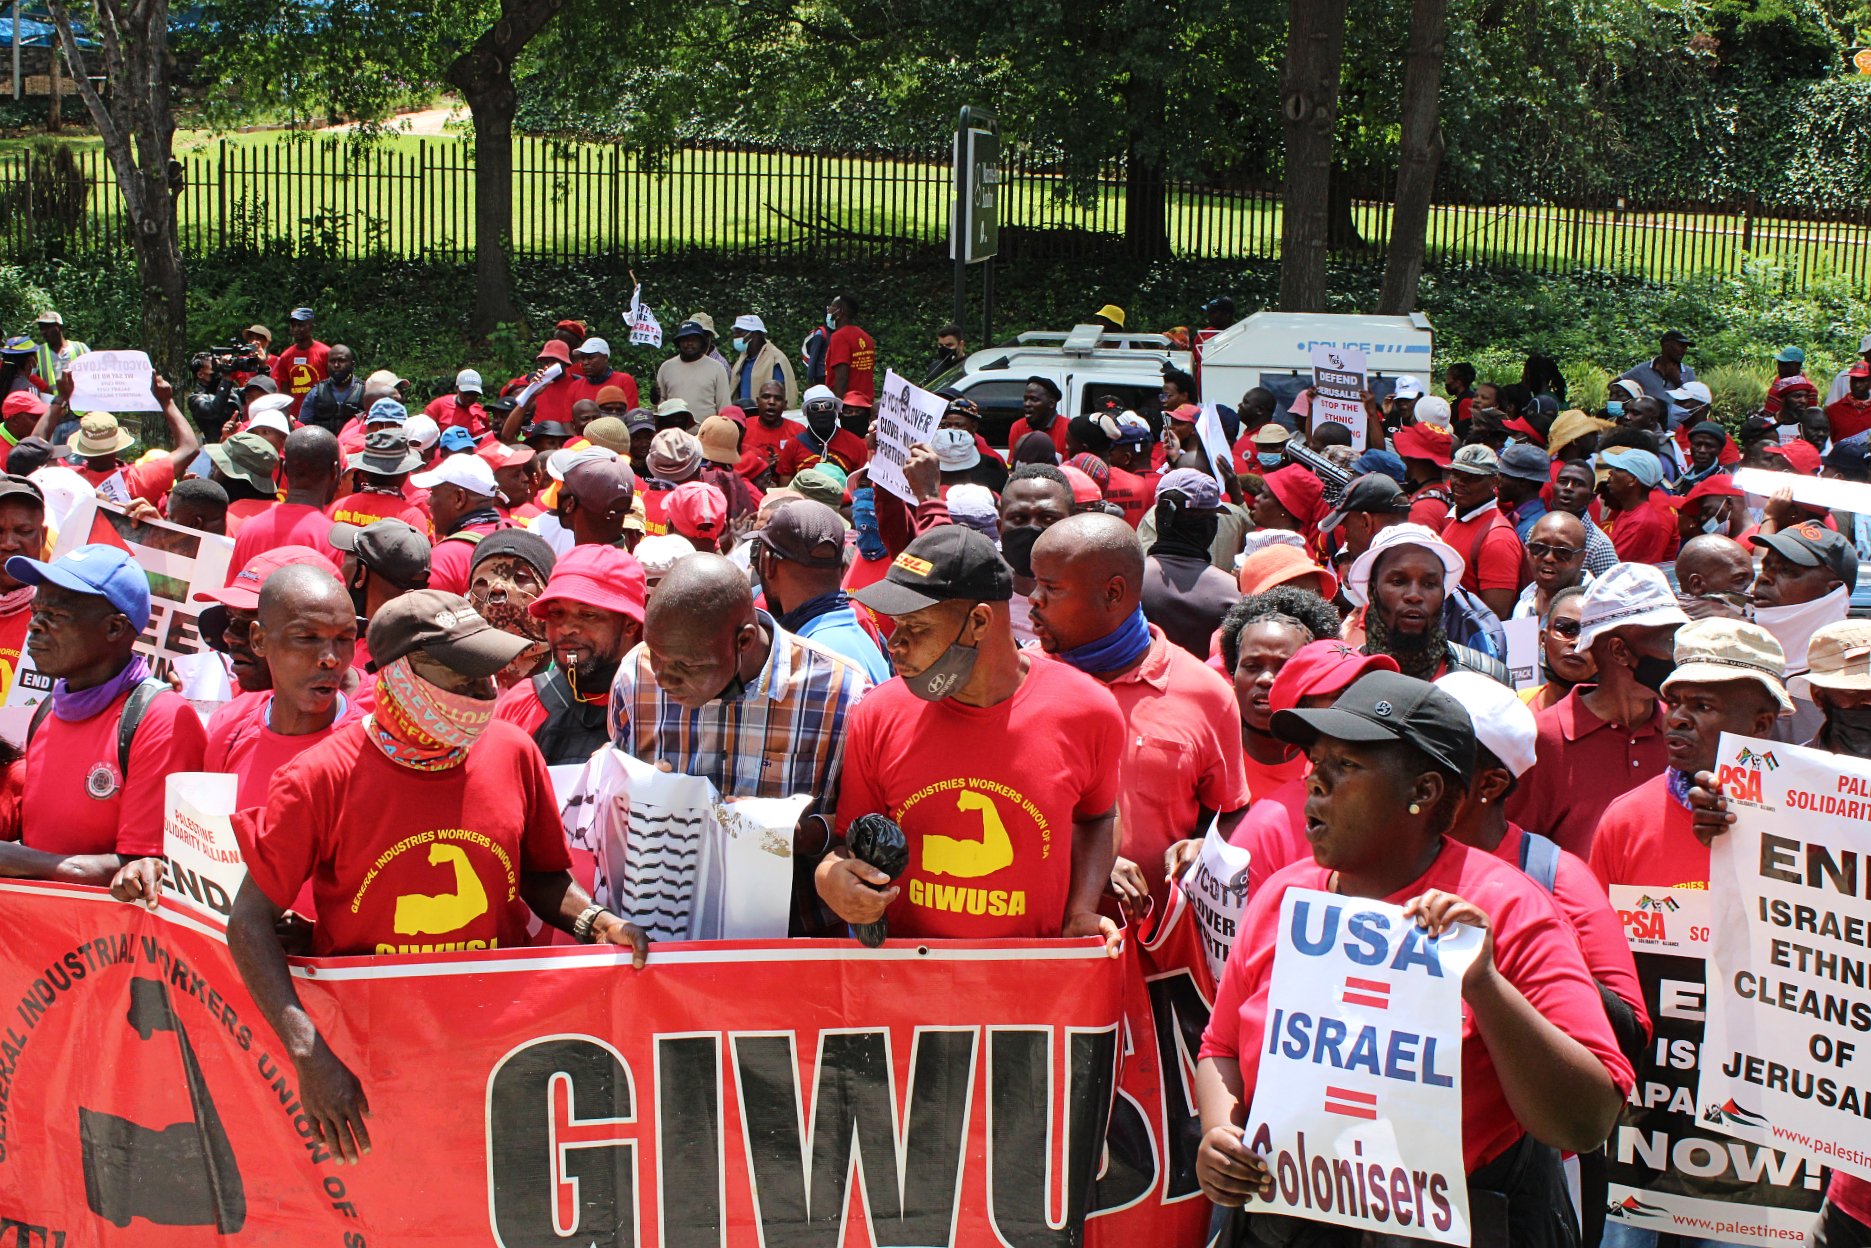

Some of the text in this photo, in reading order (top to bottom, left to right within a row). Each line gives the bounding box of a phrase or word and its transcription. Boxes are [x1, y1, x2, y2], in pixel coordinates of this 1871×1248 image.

[1308, 341, 1370, 354] PICE
[1320, 371, 1358, 385] DEFEND
[1321, 400, 1358, 412] STOP THE
[1325, 413, 1353, 424] ETHNIC
[0, 648, 20, 658] ORKE
[23, 672, 51, 689] END
[904, 777, 966, 811] INDUSTRIES
[968, 777, 1023, 804] WORKERS
[1718, 764, 1763, 803] PSA
[1837, 775, 1871, 799] PAL
[175, 809, 216, 844] PALESTINE
[1021, 799, 1048, 830] UNION
[1042, 829, 1050, 842] OF
[202, 842, 242, 864] ALLIAN
[1042, 844, 1050, 860] SA
[351, 828, 516, 914] GENERAL INDUSTRIES WORKERS UNION OF SA
[909, 878, 1026, 917] GIWUSA
[1290, 900, 1444, 978] USA
[1617, 909, 1666, 940] PSA
[1770, 938, 1871, 990] ETHN
[1268, 1008, 1454, 1088] ISRAEL
[1655, 1037, 1702, 1071] IS
[1808, 1034, 1855, 1068] OF
[17, 933, 135, 1028] INDUSTRIAL
[257, 1052, 331, 1165] UNION
[323, 1176, 358, 1218] OF
[1617, 1125, 1822, 1191] NOW!
[1251, 1121, 1452, 1232] Colonisers
[1672, 1213, 1805, 1242] www.palestinesa
